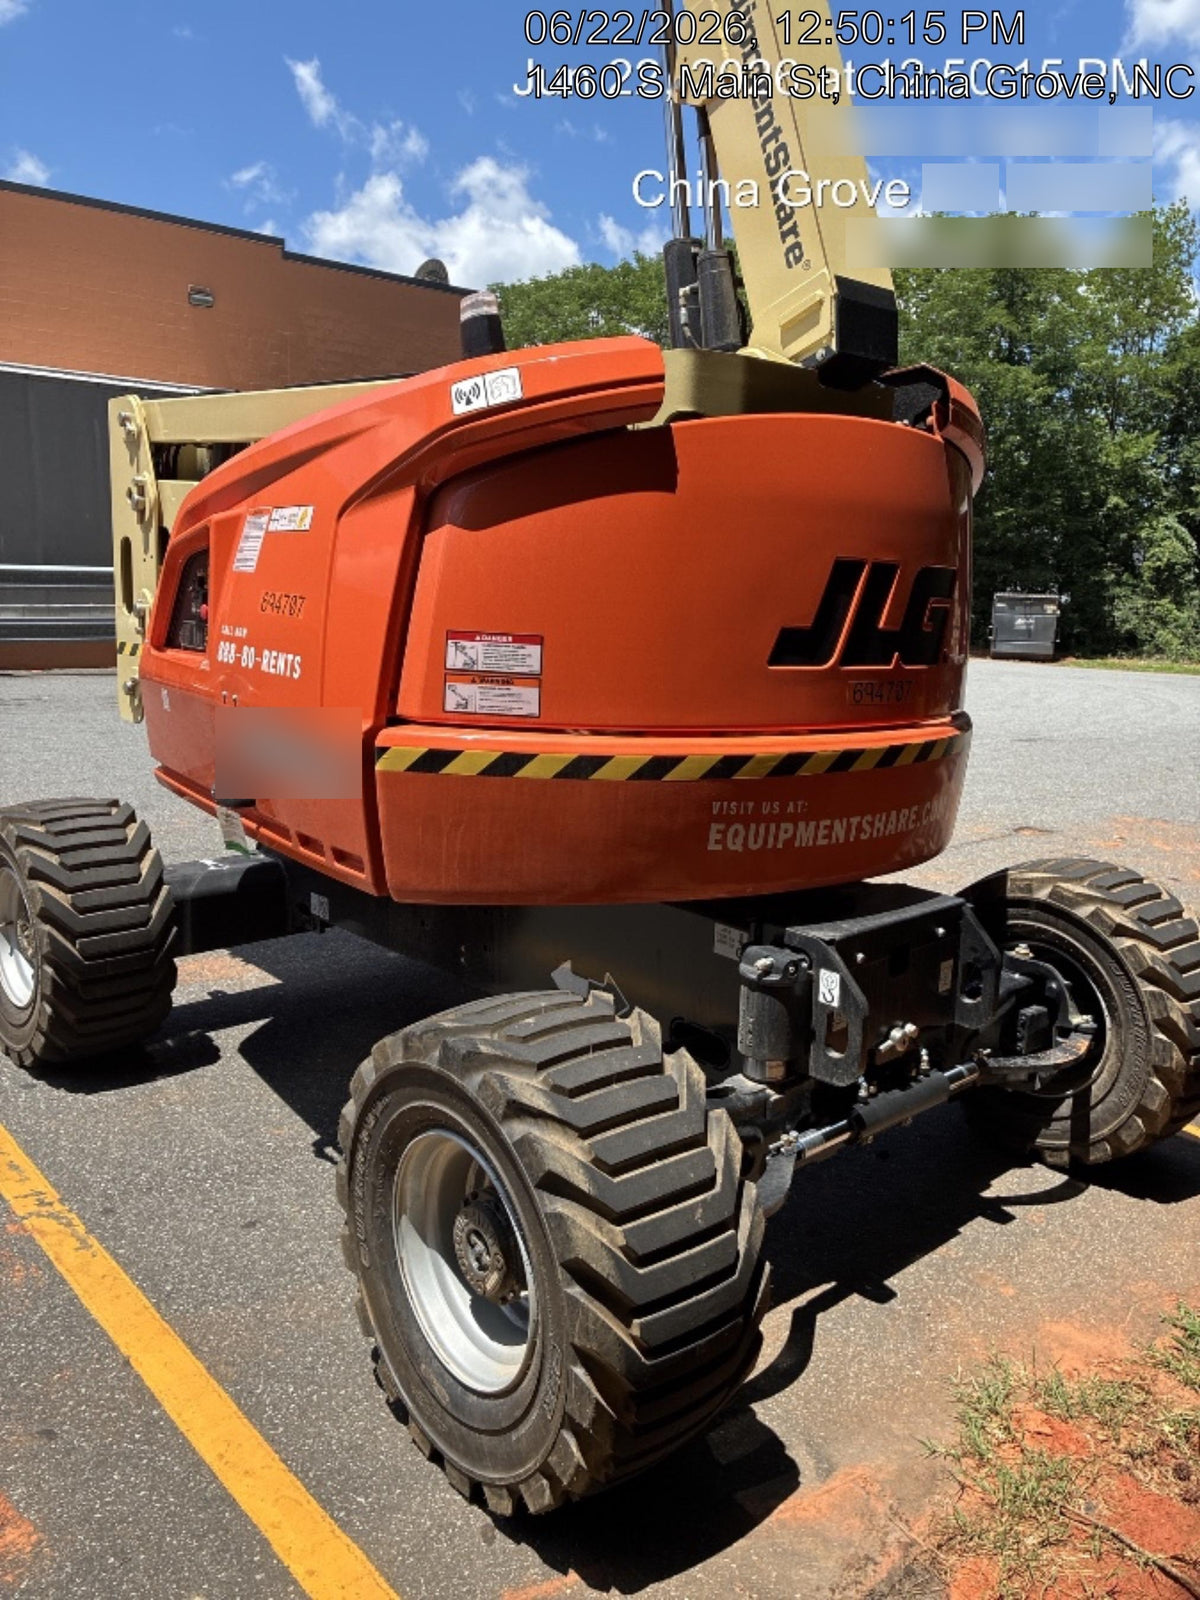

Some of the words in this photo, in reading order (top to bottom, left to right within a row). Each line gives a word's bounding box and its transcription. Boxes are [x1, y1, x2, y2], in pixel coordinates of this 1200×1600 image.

[767, 556, 957, 669] JLG
[217, 640, 301, 680] 888-80-RENTS
[711, 800, 754, 816] VISIT
[762, 800, 780, 815] US
[787, 800, 809, 815] AT:
